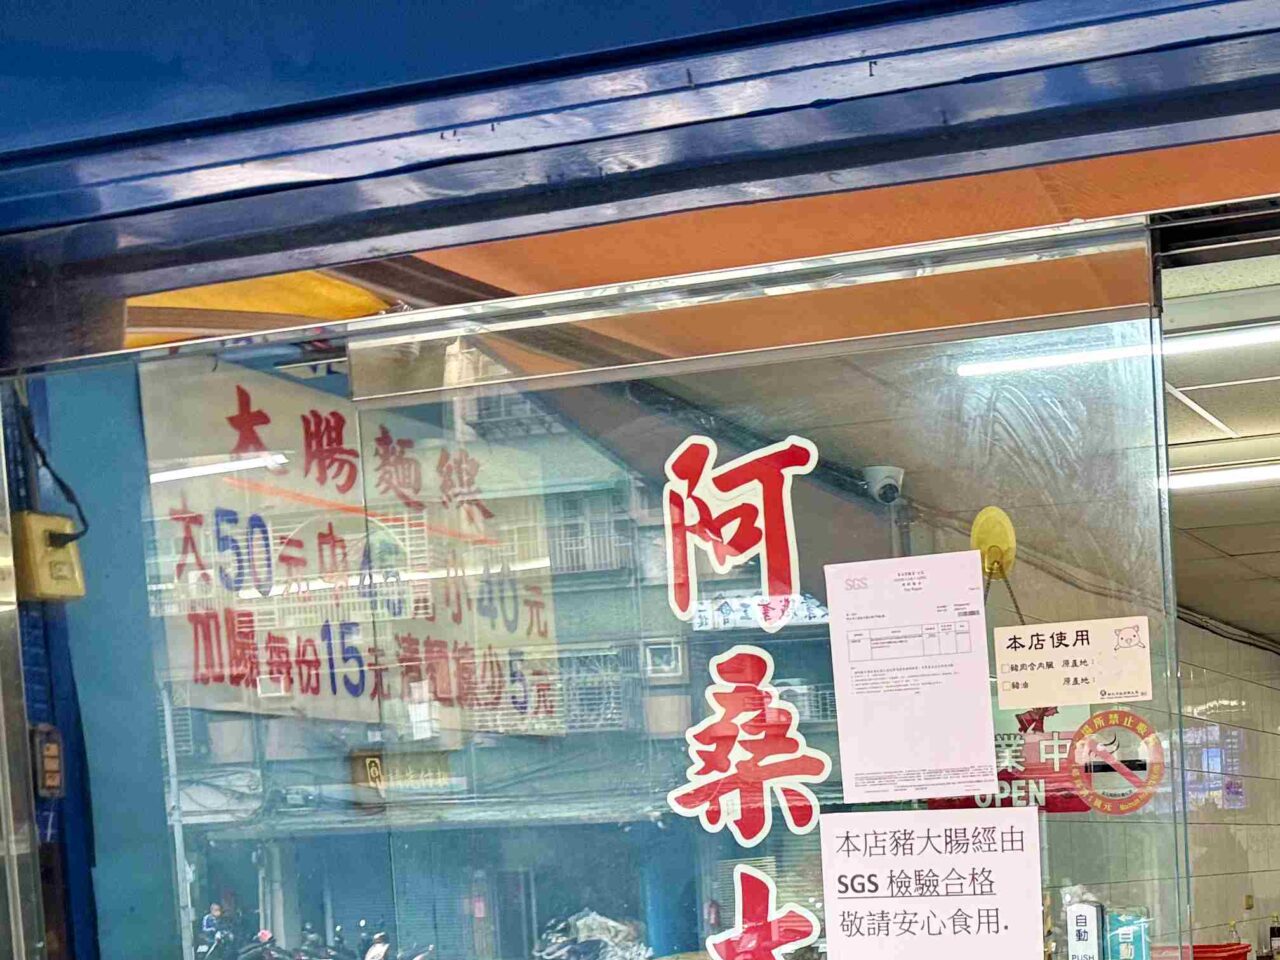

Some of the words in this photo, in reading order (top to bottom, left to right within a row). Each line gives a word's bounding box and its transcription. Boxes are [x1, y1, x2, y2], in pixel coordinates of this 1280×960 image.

[1006, 629, 1091, 652] 本店使用
[835, 825, 1025, 858] 本店豬大腸經由
[837, 873, 879, 894] SGS
[887, 867, 996, 897] 檢驗合格
[838, 907, 1010, 938] 敬請安心食用.
[1075, 913, 1089, 943] 自動
